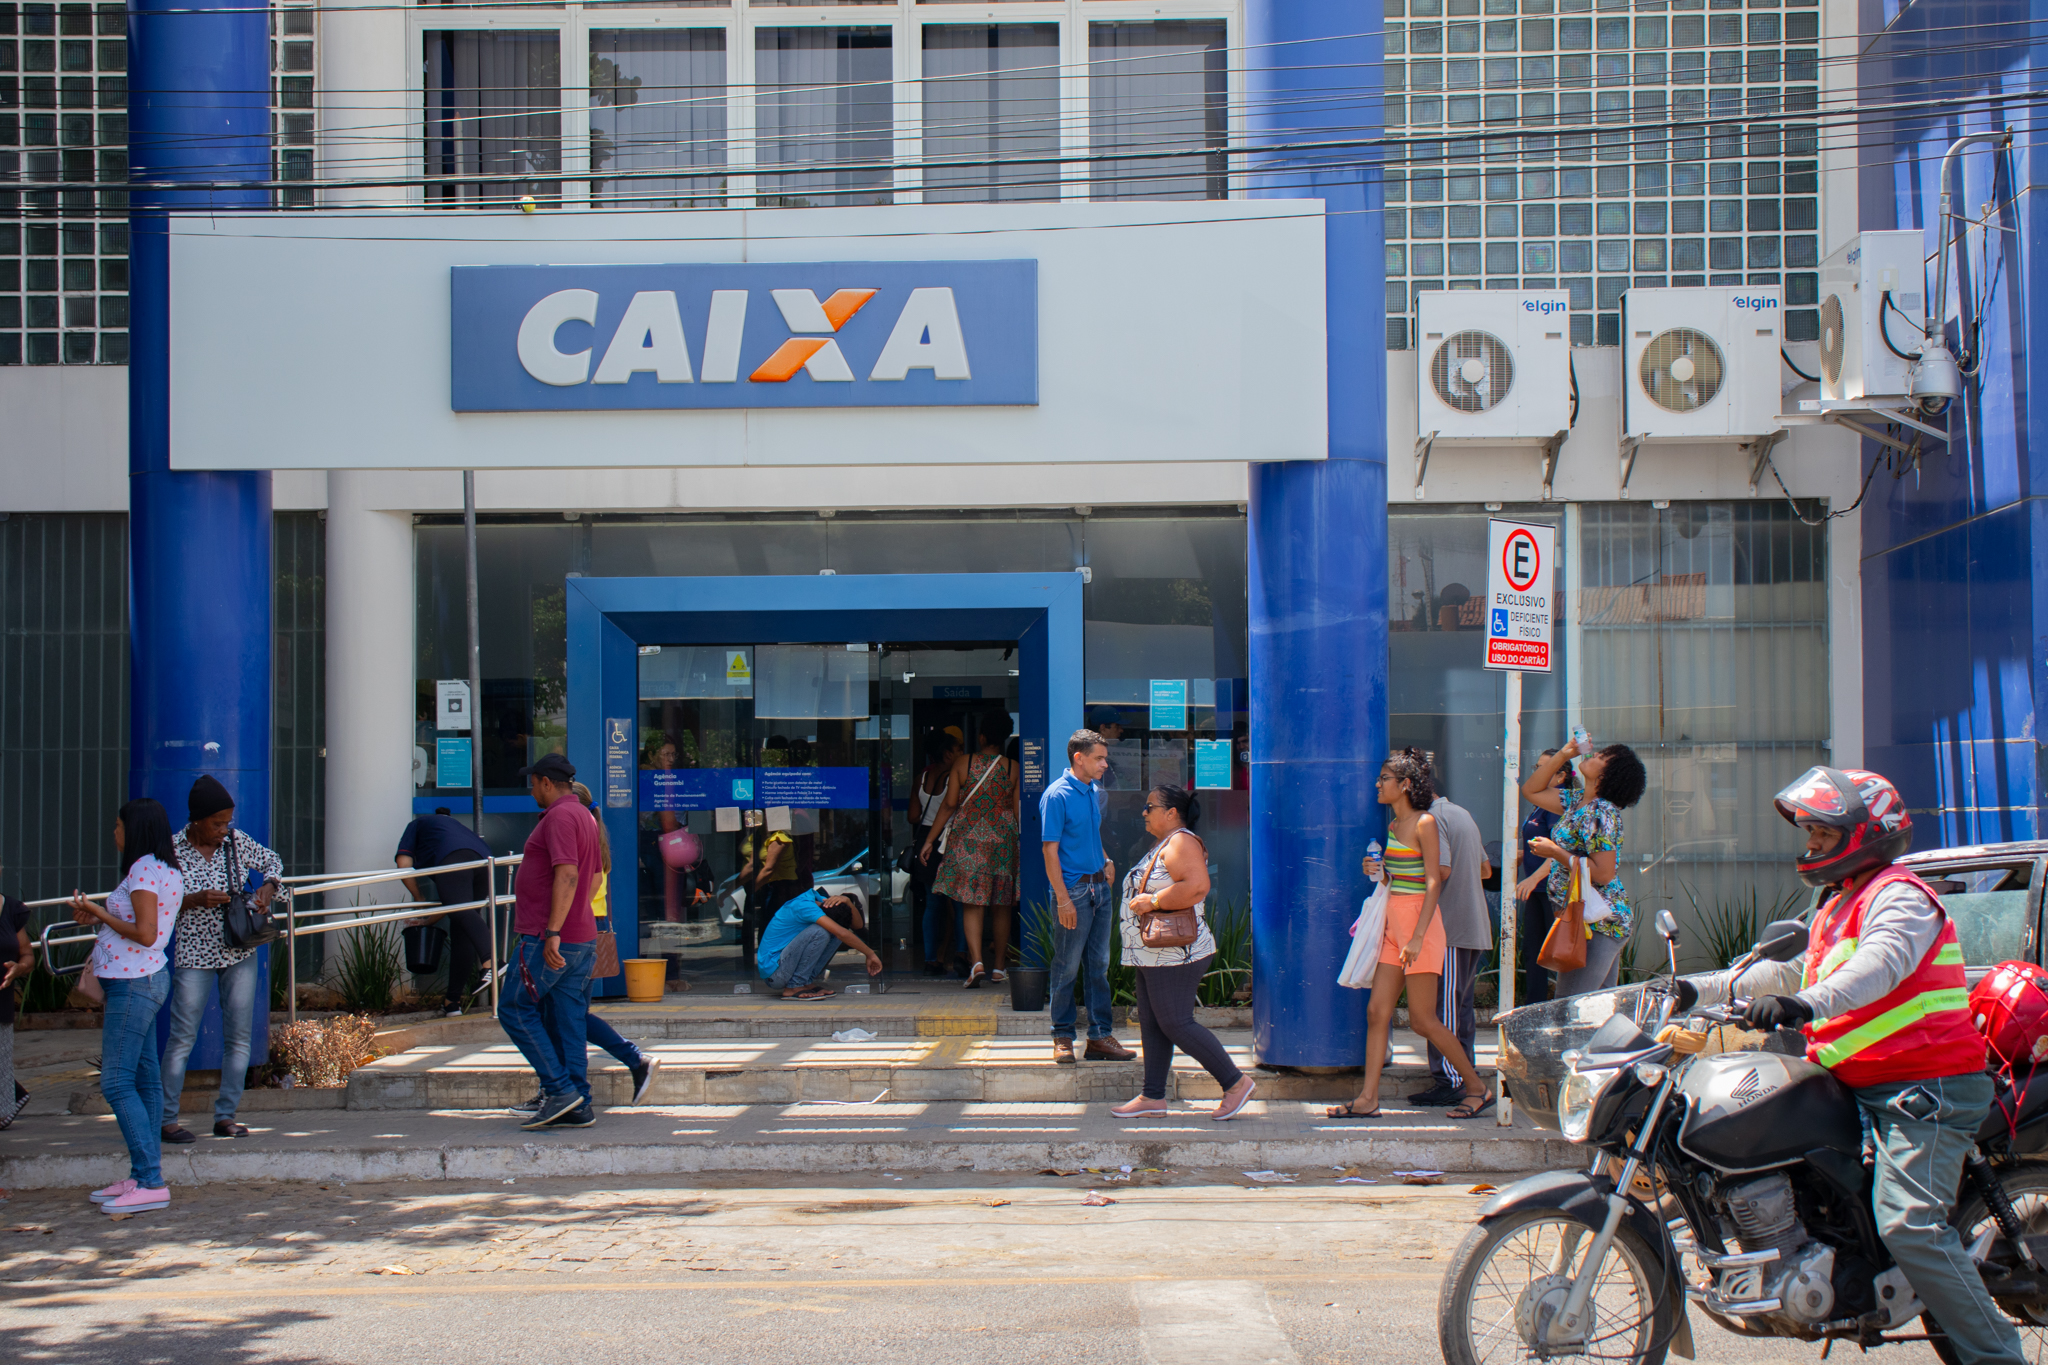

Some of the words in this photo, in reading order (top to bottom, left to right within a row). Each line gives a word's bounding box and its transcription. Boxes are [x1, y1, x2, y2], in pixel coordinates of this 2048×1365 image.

[1522, 300, 1567, 315] elgin
[1732, 296, 1778, 311] elgin
[517, 287, 972, 386] CAIXA
[1514, 541, 1530, 579] E
[1496, 593, 1546, 608] EXCLUSIVO
[1510, 611, 1549, 625] DEFICIENTE
[1519, 624, 1541, 638] FÍSICO
[1492, 641, 1540, 654] OBRIGATÓRIO
[1540, 646, 1546, 654] O
[1491, 653, 1507, 663] USO
[1508, 655, 1519, 664] DO
[1519, 655, 1546, 665] CARTÃO
[944, 687, 970, 697] Saída
[1738, 1085, 1778, 1108] HONDA
